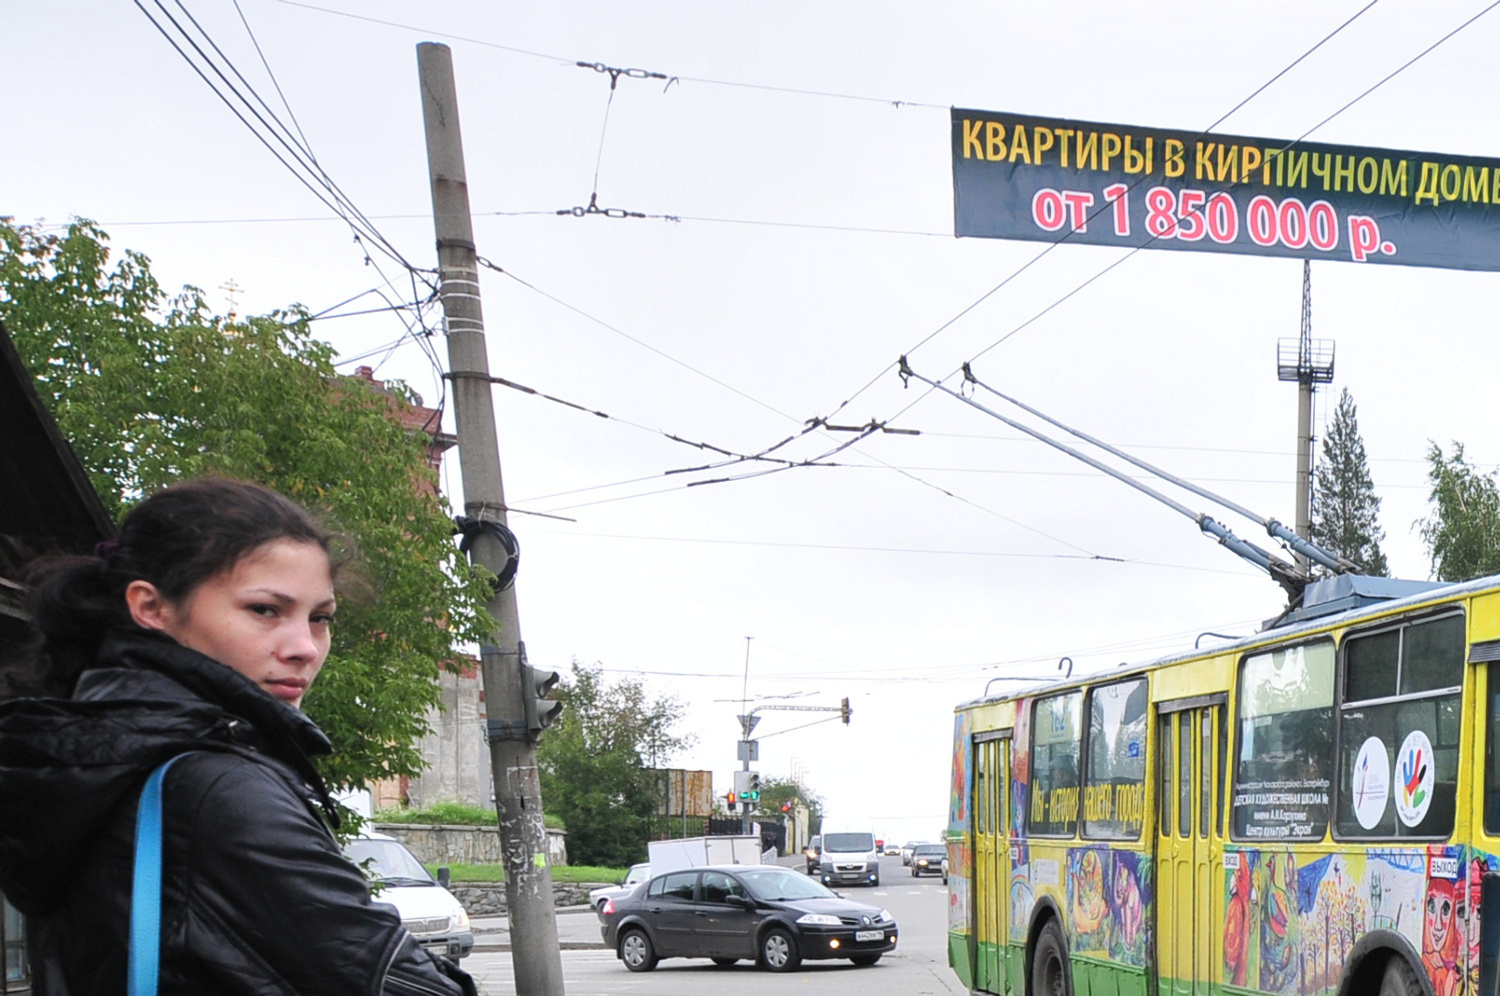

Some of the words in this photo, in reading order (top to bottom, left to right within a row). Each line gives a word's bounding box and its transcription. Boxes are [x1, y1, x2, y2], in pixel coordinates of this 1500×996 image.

[962, 119, 1153, 175] КВАРТИРЫ
[1164, 138, 1185, 178] В
[1195, 141, 1408, 197] КИРПИЧНОМ
[1032, 188, 1094, 233] от
[1103, 183, 1130, 236] 1
[1145, 186, 1239, 244] 850
[1246, 195, 1339, 250] 000
[1347, 214, 1396, 262] р.
[1031, 778, 1044, 823] Мы
[1083, 783, 1112, 822] нашего
[1115, 783, 1143, 833] город
[1301, 793, 1321, 804] ШКОЛА
[1432, 861, 1457, 875] ВЫХОД
